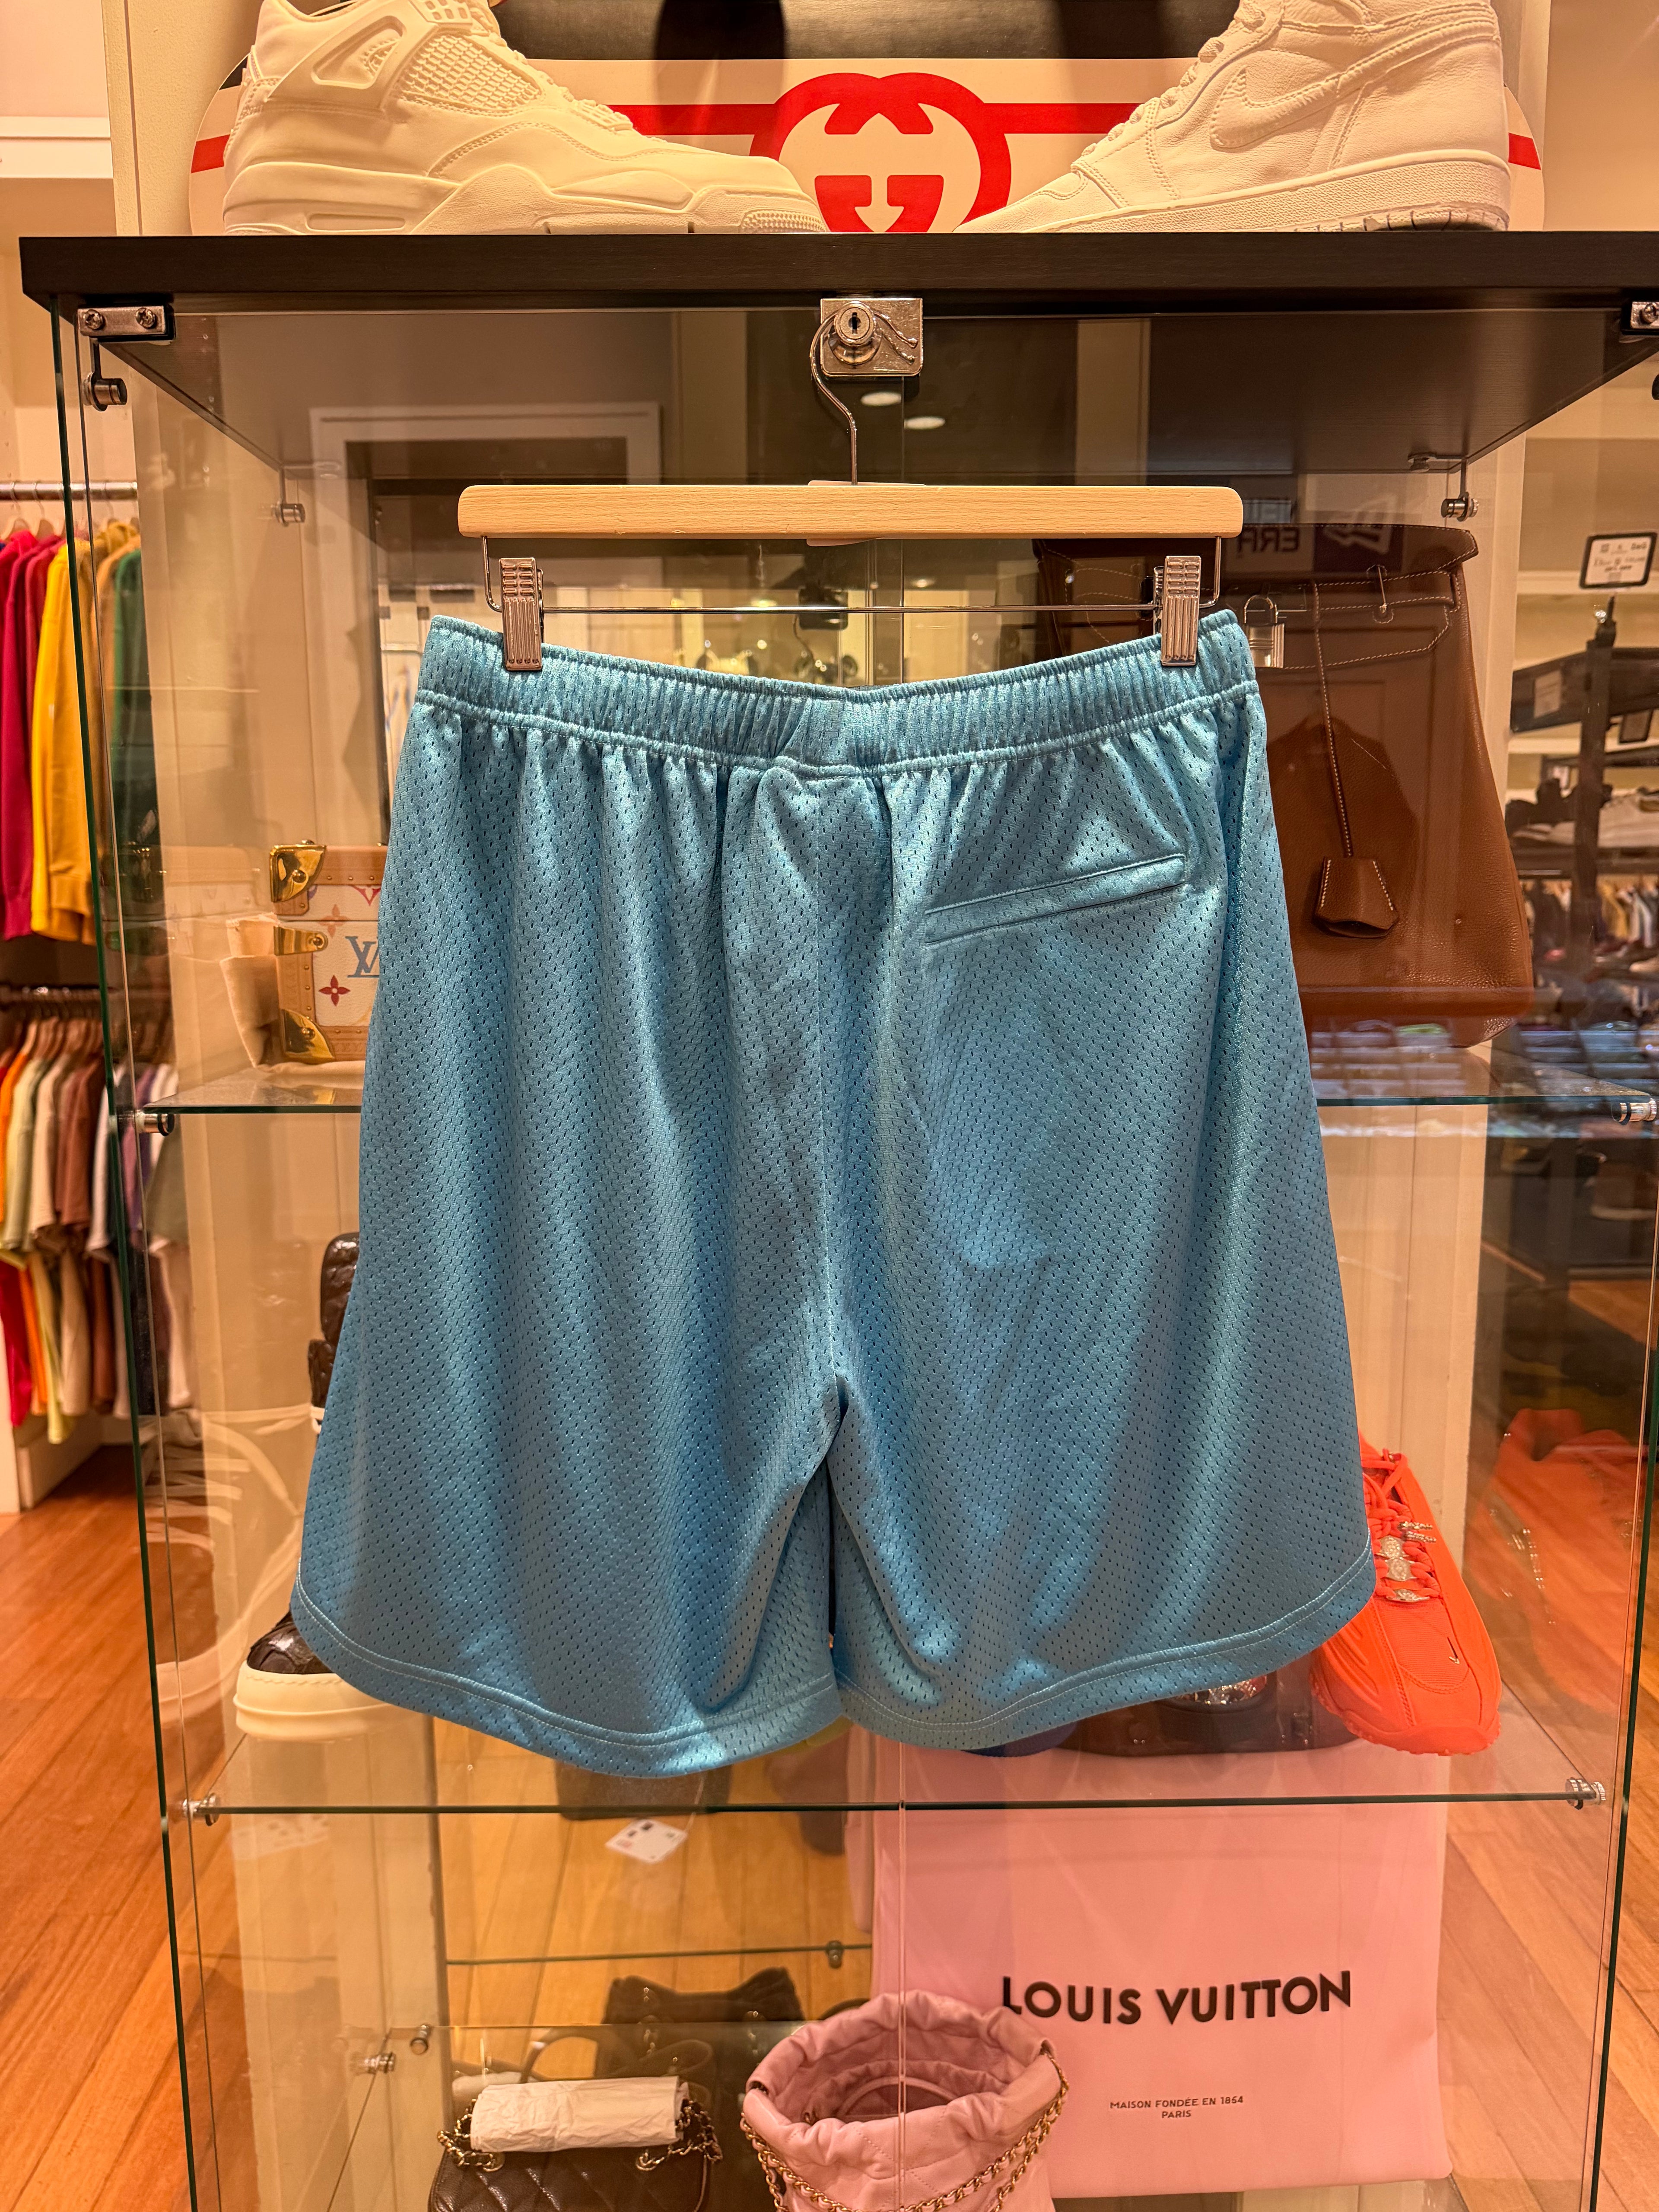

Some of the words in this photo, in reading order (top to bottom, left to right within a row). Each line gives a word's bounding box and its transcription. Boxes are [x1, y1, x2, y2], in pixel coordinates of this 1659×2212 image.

[1003, 1976, 1141, 2024] LOUIS
[1156, 1970, 1350, 2025] VUITTON
[1110, 2101, 1151, 2109] MAISON
[1155, 2098, 1198, 2107] FONDÉE
[1161, 2110, 1192, 2118] PARIS
